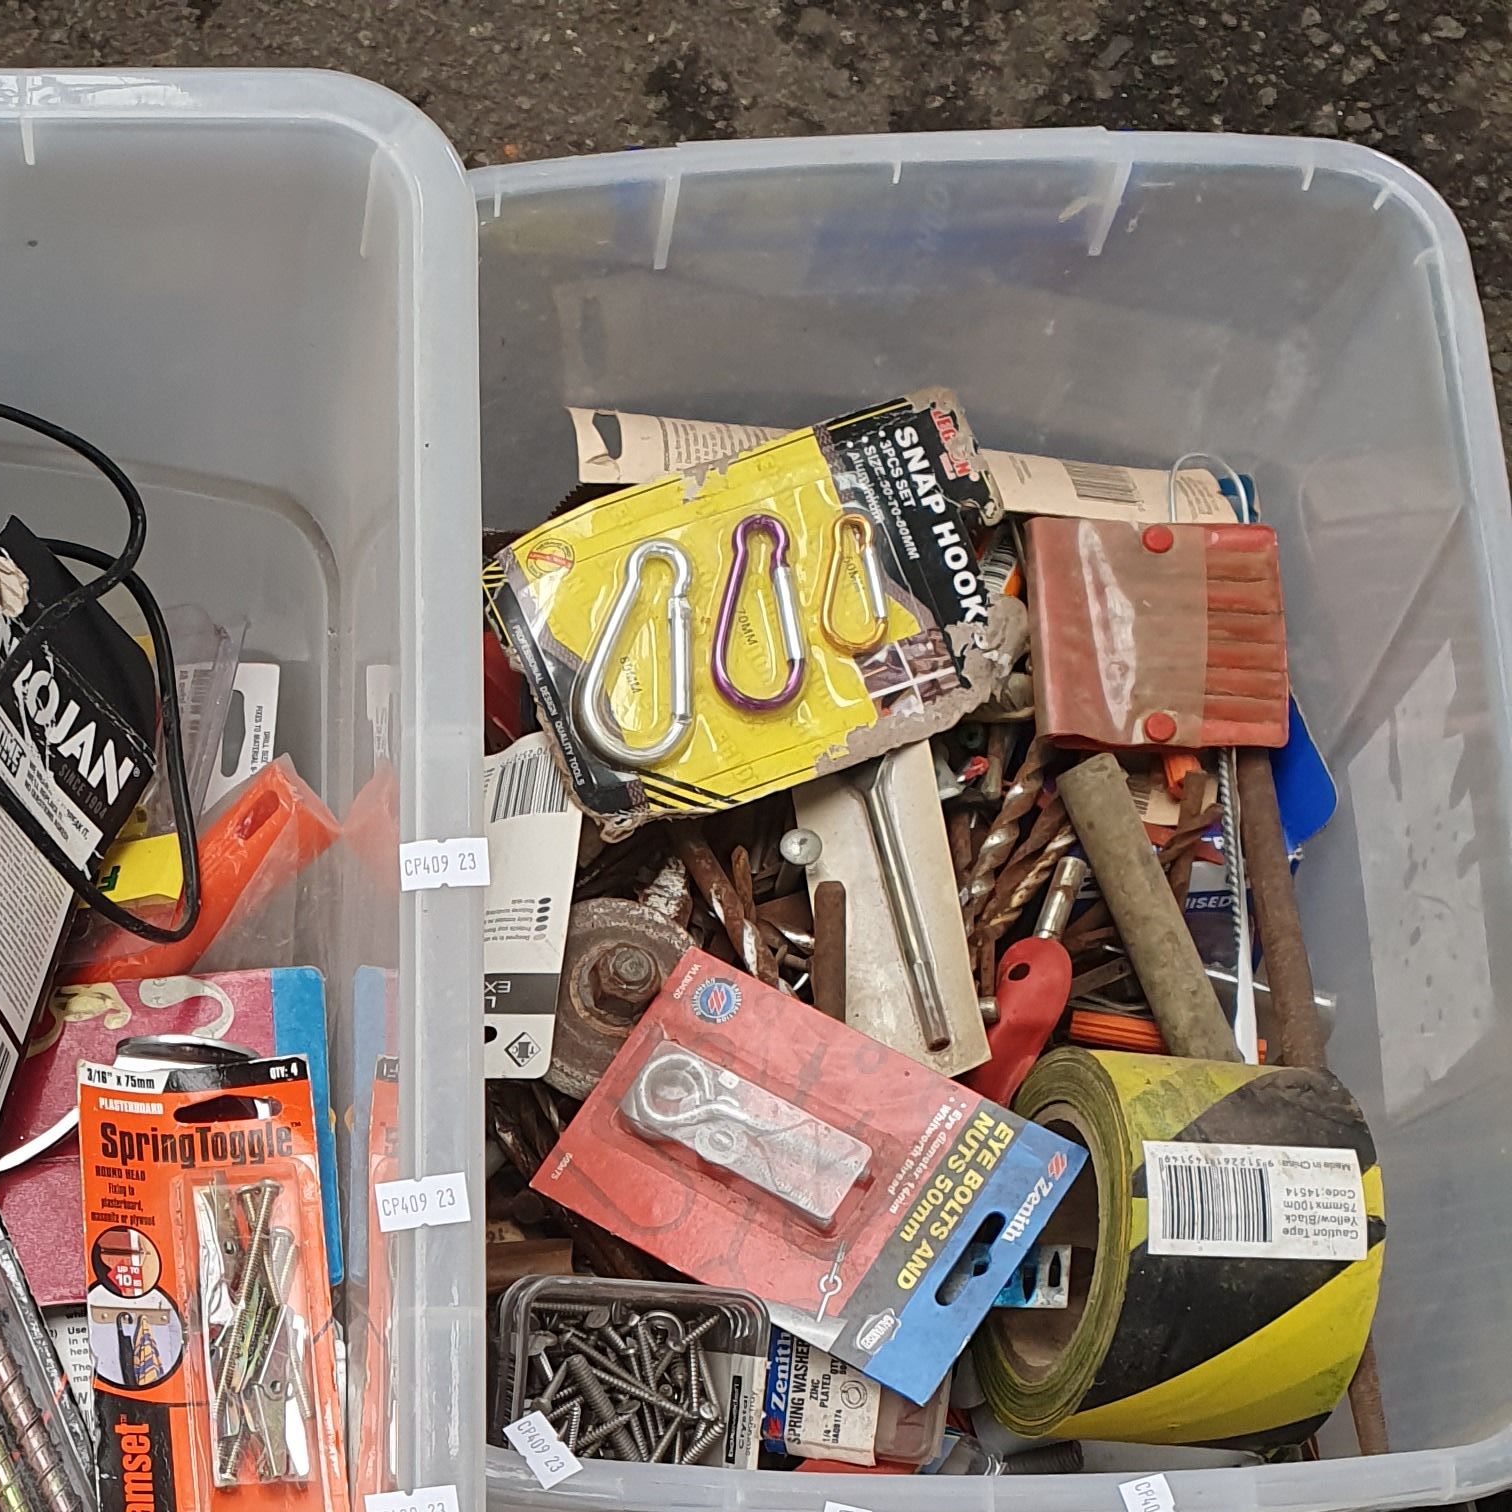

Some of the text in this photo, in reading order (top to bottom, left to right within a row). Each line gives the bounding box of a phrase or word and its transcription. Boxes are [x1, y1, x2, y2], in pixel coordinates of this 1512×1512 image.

[879, 440, 916, 507] 3PCS SET
[895, 426, 945, 515] SNAP
[512, 624, 585, 786] PROFESSIONAL DESIGN QUALITY TOOLS
[59, 763, 107, 819] SINCE 1904
[404, 852, 477, 877] CP409 23
[125, 1074, 155, 1089] 75mm
[269, 1063, 299, 1079] QTY: 4
[98, 1097, 164, 1114] PLASTERBOARD
[946, 1109, 963, 1130] Eye
[100, 1122, 293, 1169] SpringToggle
[888, 1104, 952, 1196] Whitworth thread
[914, 1131, 947, 1180] diameter
[95, 1165, 146, 1181] ROUND HEAD
[899, 1111, 995, 1242] NUTS 50mm
[382, 1188, 455, 1216] CP409 23
[897, 1121, 1015, 1290] EYE BOLTS AND
[1001, 1176, 1054, 1243] Zenith
[1283, 1200, 1357, 1213] 75mmx100m
[1285, 1187, 1356, 1200] Code:14514
[1282, 1226, 1359, 1240] Caution Tape
[1284, 1214, 1359, 1226] Yellow/Black
[115, 1274, 132, 1287] 10
[772, 1331, 791, 1411] Zenith
[809, 1379, 818, 1401] ZINC
[819, 1374, 831, 1408] PLATED
[788, 1396, 804, 1445] SPRING
[517, 1420, 565, 1473] CP409 23
